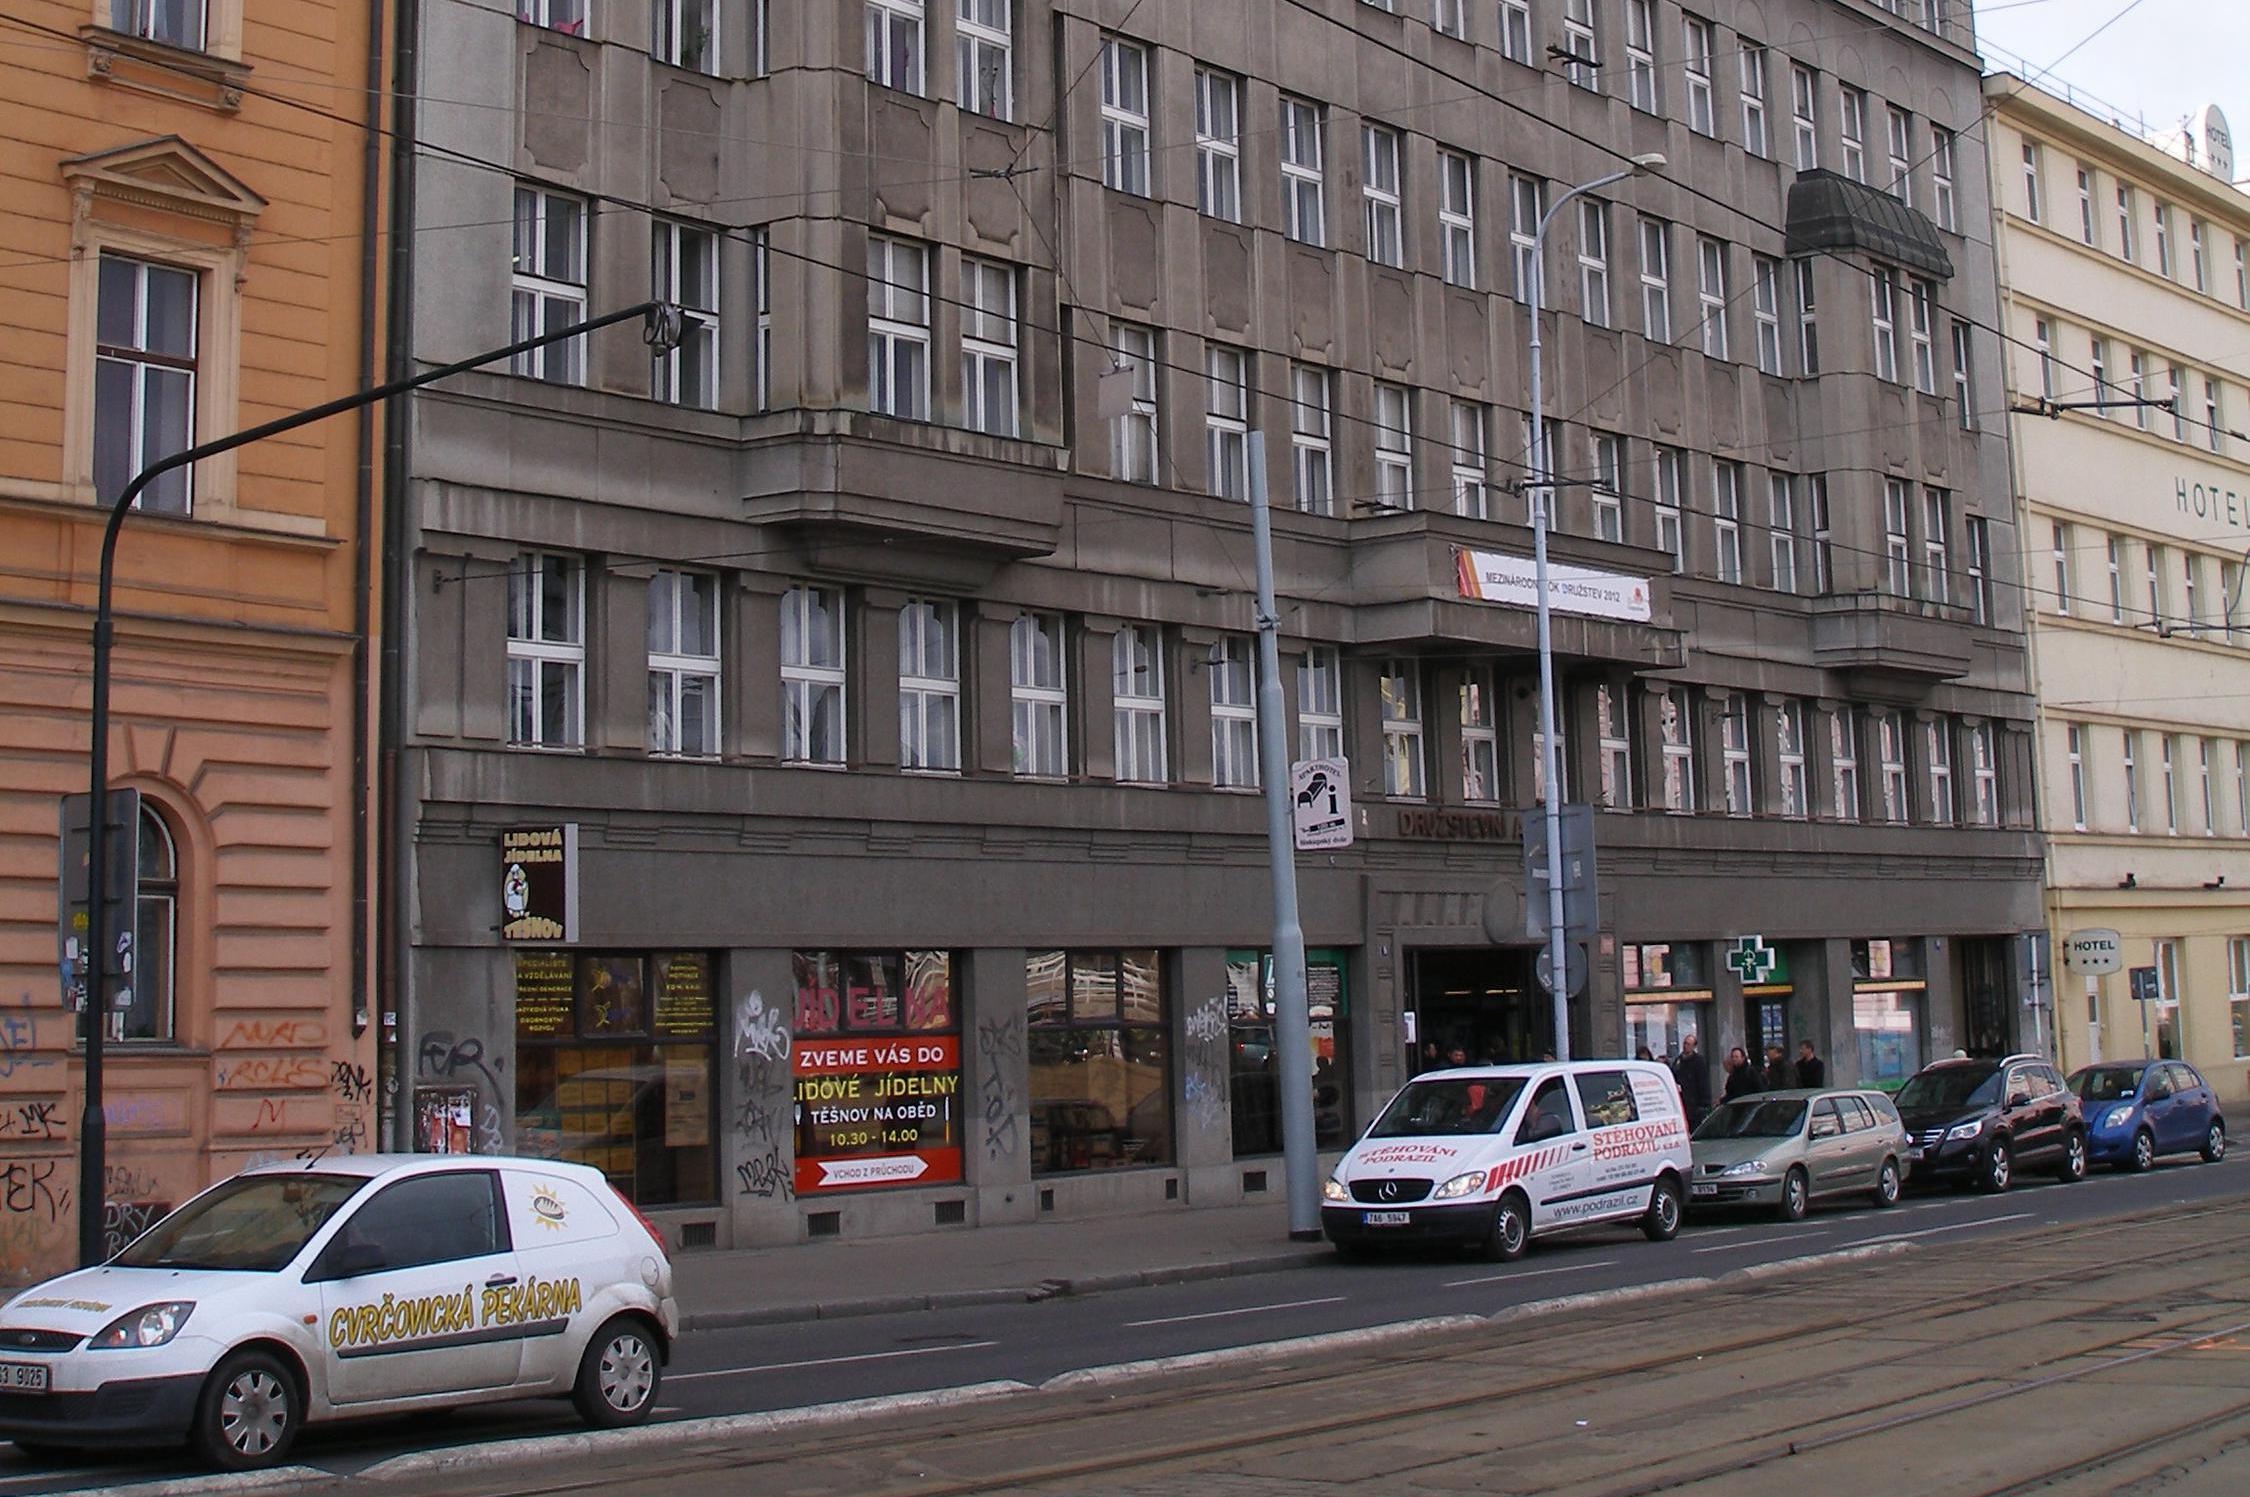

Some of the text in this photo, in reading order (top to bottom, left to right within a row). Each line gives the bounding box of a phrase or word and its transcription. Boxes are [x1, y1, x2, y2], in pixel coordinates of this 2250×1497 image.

[2206, 123, 2232, 150] HOTEL
[2175, 476, 2250, 529] HOTEL
[1486, 571, 1539, 590] MEZINÁRODN
[1603, 590, 1621, 603] 2012
[503, 828, 562, 847] LIDOVÁ
[503, 847, 563, 863] JÍDELNA
[503, 911, 563, 939] TĚŠNOV
[2074, 940, 2115, 951] HOTEL
[800, 1042, 944, 1068] ZVEME VÁS DO
[793, 1072, 958, 1101] IDOVÉ JÍDELNY
[811, 1101, 936, 1125] TĚŠNOV NA OBĚD
[830, 1132, 868, 1147] 10.30
[881, 1129, 918, 1143] 14.00
[1593, 1119, 1678, 1146] STĚHOVÁNÍ
[1363, 1154, 1436, 1165] PODRAZIL
[1593, 1140, 1659, 1161] PODRAZIL
[833, 1163, 914, 1180] VCHOD Z PRŮCHODU
[1553, 1195, 1638, 1217] www.podrazil.cz
[328, 1275, 582, 1348] CVRČOVICKÁ PEKÁRNA
